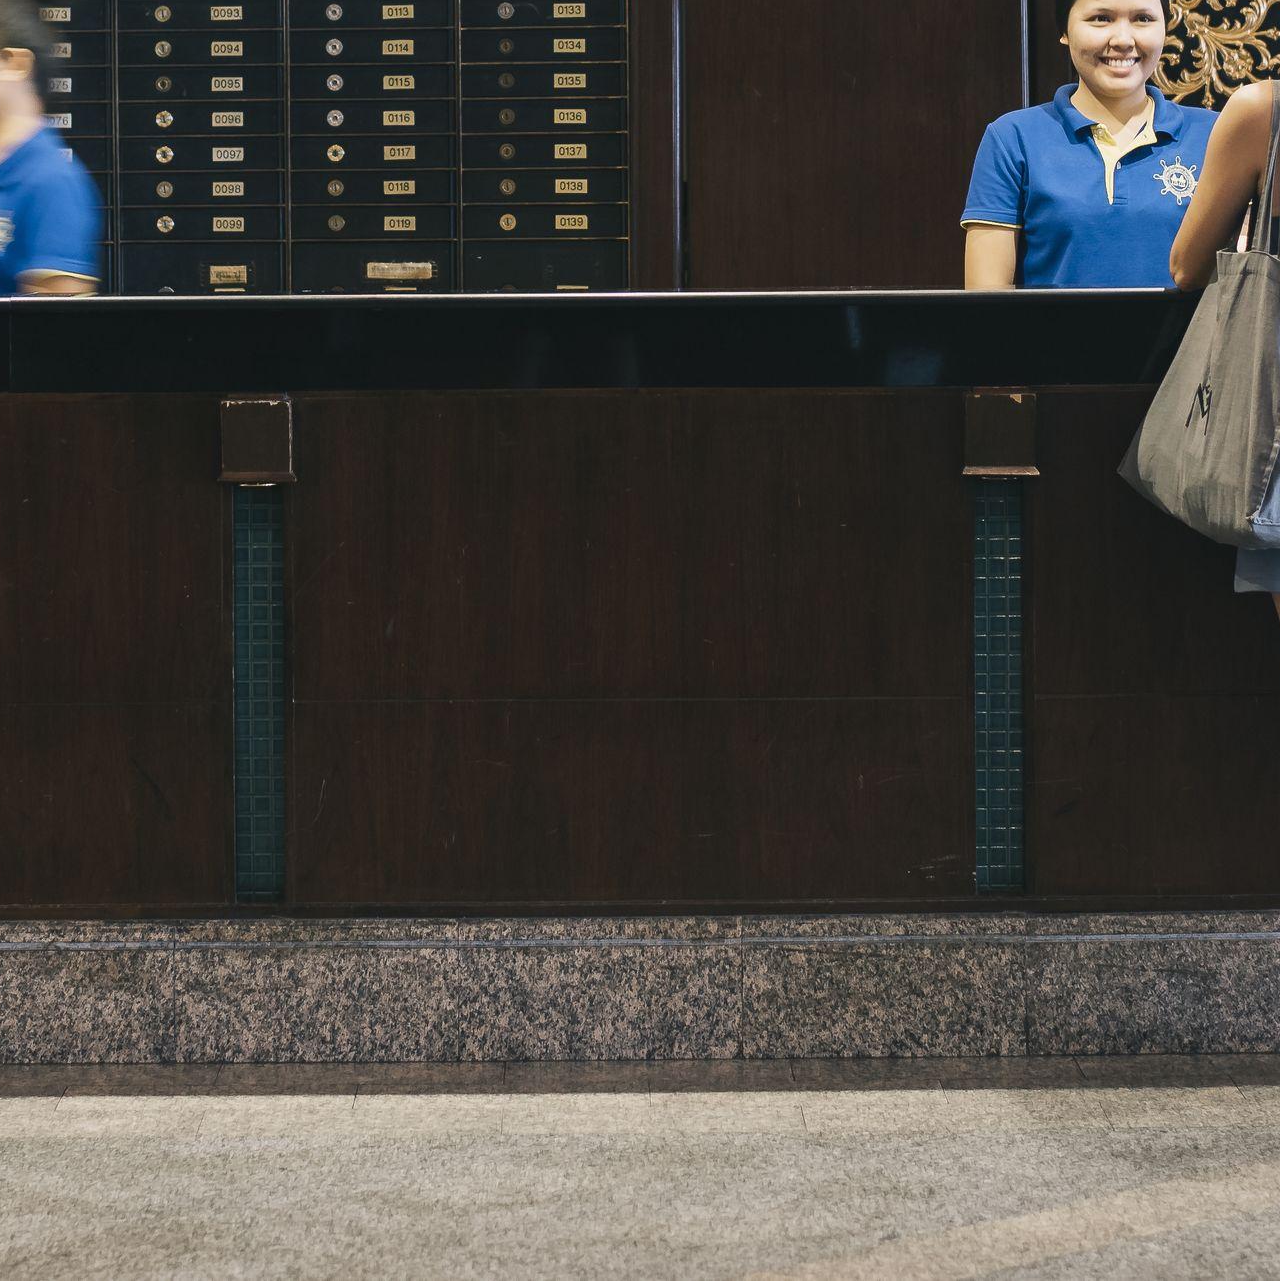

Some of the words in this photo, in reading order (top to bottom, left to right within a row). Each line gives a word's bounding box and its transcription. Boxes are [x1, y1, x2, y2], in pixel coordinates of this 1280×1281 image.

[41, 10, 68, 20] 0073
[213, 8, 240, 18] 0093
[387, 7, 409, 17] 0113
[558, 5, 581, 15] 0133
[213, 44, 240, 54] 0094
[387, 43, 409, 52] 0114
[558, 40, 582, 50] 0134
[214, 79, 240, 89] 0095
[388, 77, 410, 87] 0115
[558, 76, 581, 86] 0135
[215, 114, 241, 124] 0096
[388, 113, 410, 123] 0116
[558, 111, 582, 121] 0136
[216, 149, 242, 159] 0097
[389, 147, 411, 157] 0117
[559, 146, 582, 156] 0137
[214, 184, 241, 194] 0098
[388, 182, 410, 192] 0118
[560, 181, 583, 191] 0138
[216, 219, 242, 229] 0099
[389, 219, 411, 228] 0119
[560, 217, 584, 227] 0139
